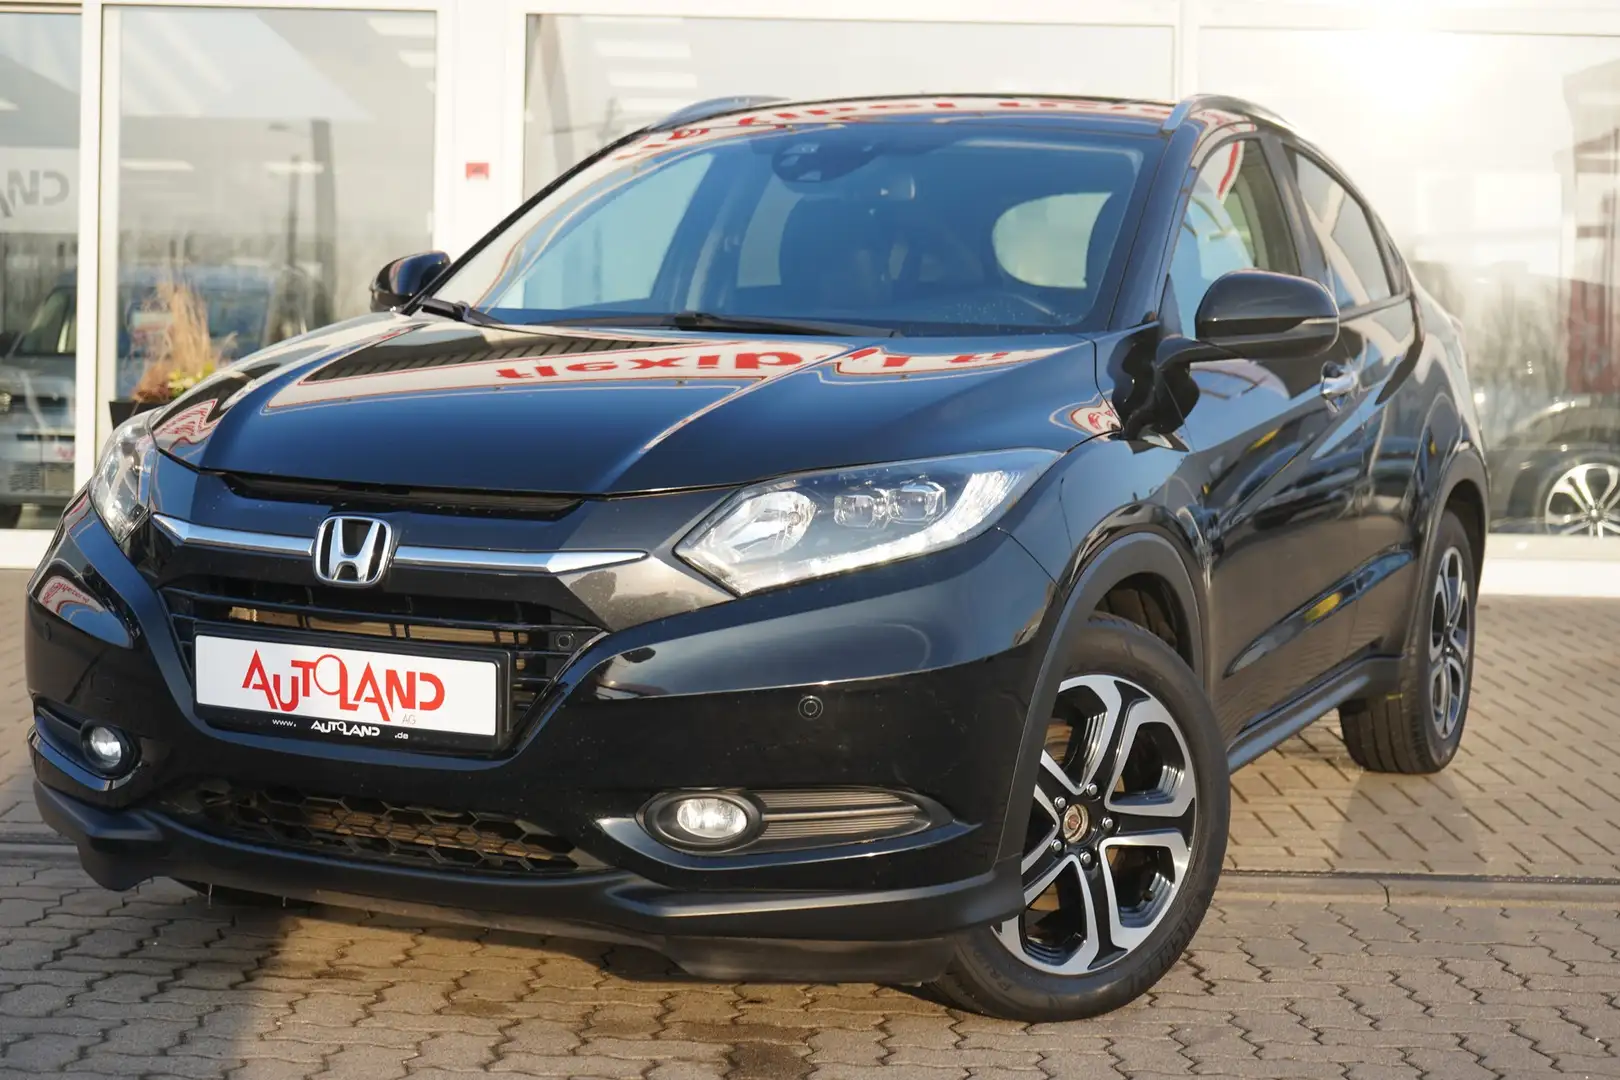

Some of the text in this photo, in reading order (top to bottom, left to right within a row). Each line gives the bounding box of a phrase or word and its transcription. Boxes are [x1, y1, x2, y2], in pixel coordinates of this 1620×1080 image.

[242, 649, 445, 722] AUTOLAND
[272, 718, 297, 728] www.
[310, 719, 381, 738] AUTOLAND
[401, 713, 417, 725] AG
